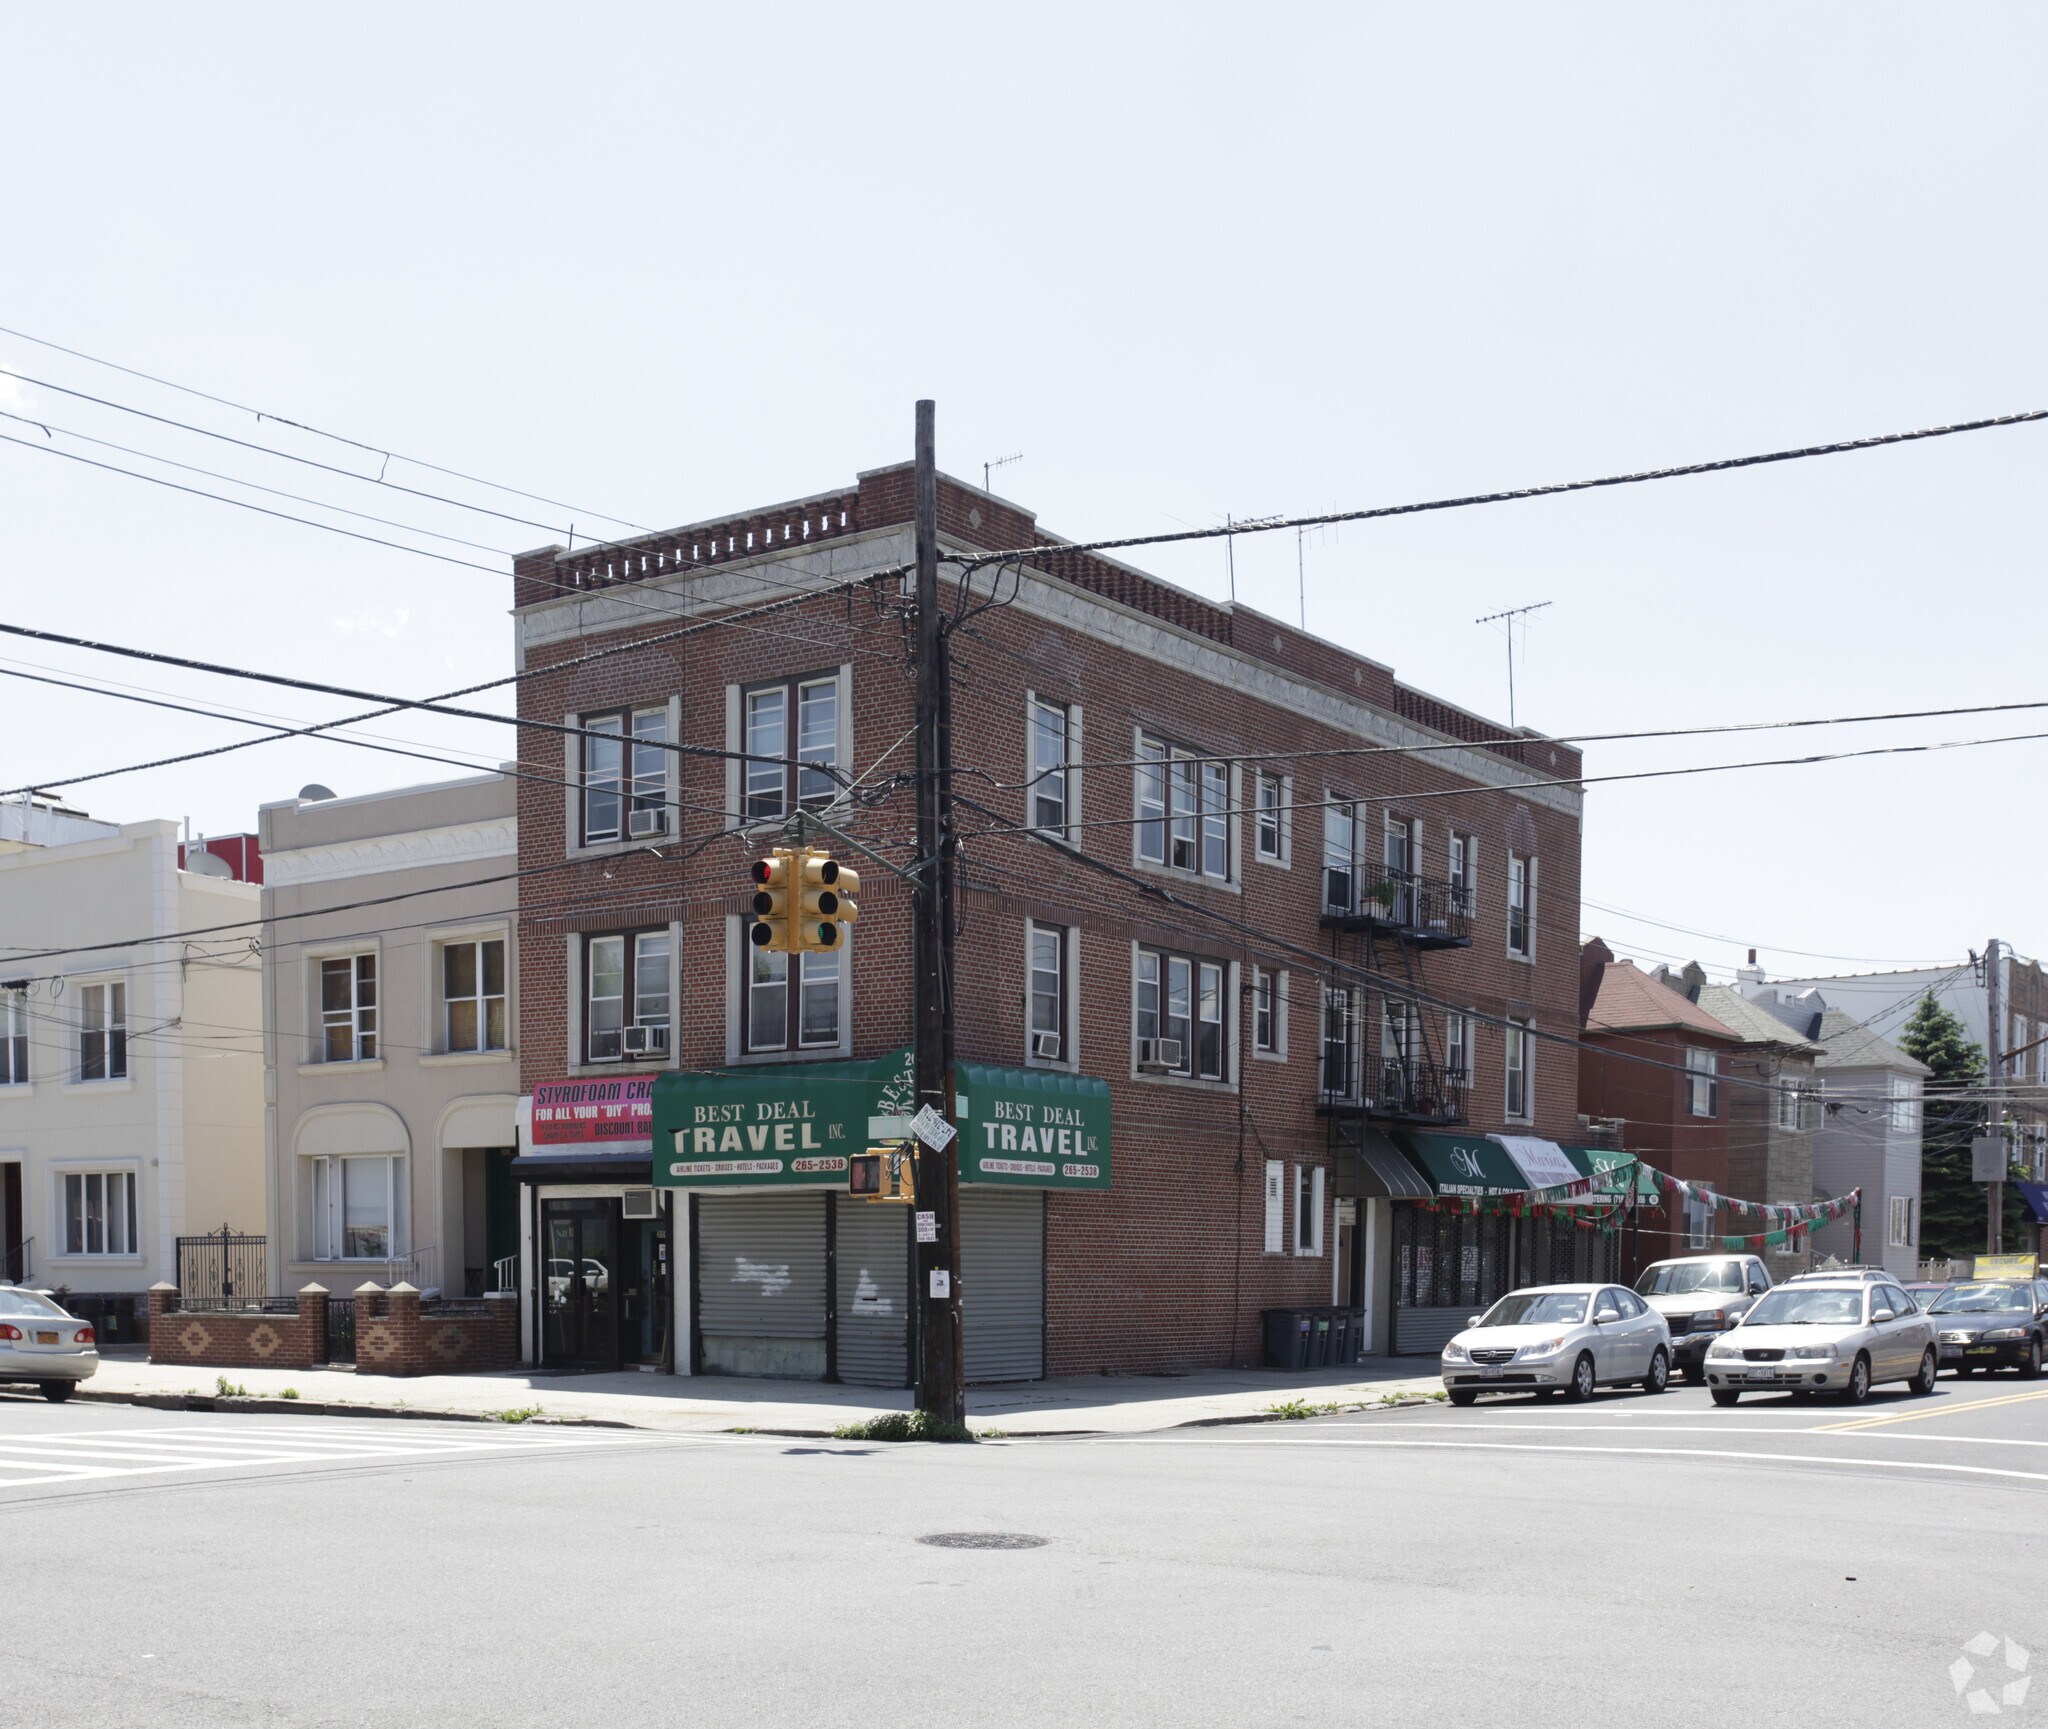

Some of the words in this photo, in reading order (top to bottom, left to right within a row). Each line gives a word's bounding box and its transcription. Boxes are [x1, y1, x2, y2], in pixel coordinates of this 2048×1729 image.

[537, 1082, 622, 1105] STYROFOAM
[535, 1108, 553, 1121] FOR
[555, 1107, 571, 1120] ALL
[573, 1105, 598, 1119] YOUR
[694, 1103, 745, 1123] BEST
[756, 1100, 816, 1121] DEAL
[994, 1100, 1034, 1122] BEST
[1042, 1105, 1085, 1127] DEAL
[594, 1121, 634, 1136] DISCOUNT
[669, 1122, 822, 1154] TRAVEL
[828, 1123, 846, 1139] INC.
[982, 1121, 1088, 1156] TRAVEL
[676, 1163, 692, 1173] AIRLINE
[693, 1163, 711, 1173] TICKETS
[715, 1162, 734, 1172] CRUISES
[736, 1162, 753, 1171] HOTELS
[755, 1161, 779, 1171] PACKAGES
[795, 1158, 844, 1171] 265-2538
[1064, 1164, 1098, 1177] 265-2538
[1450, 1146, 1487, 1179] M
[1439, 1183, 1457, 1194] ITALIAN
[1457, 1184, 1484, 1196] SPECIALTIES
[1990, 1257, 2018, 1265] SECURE
